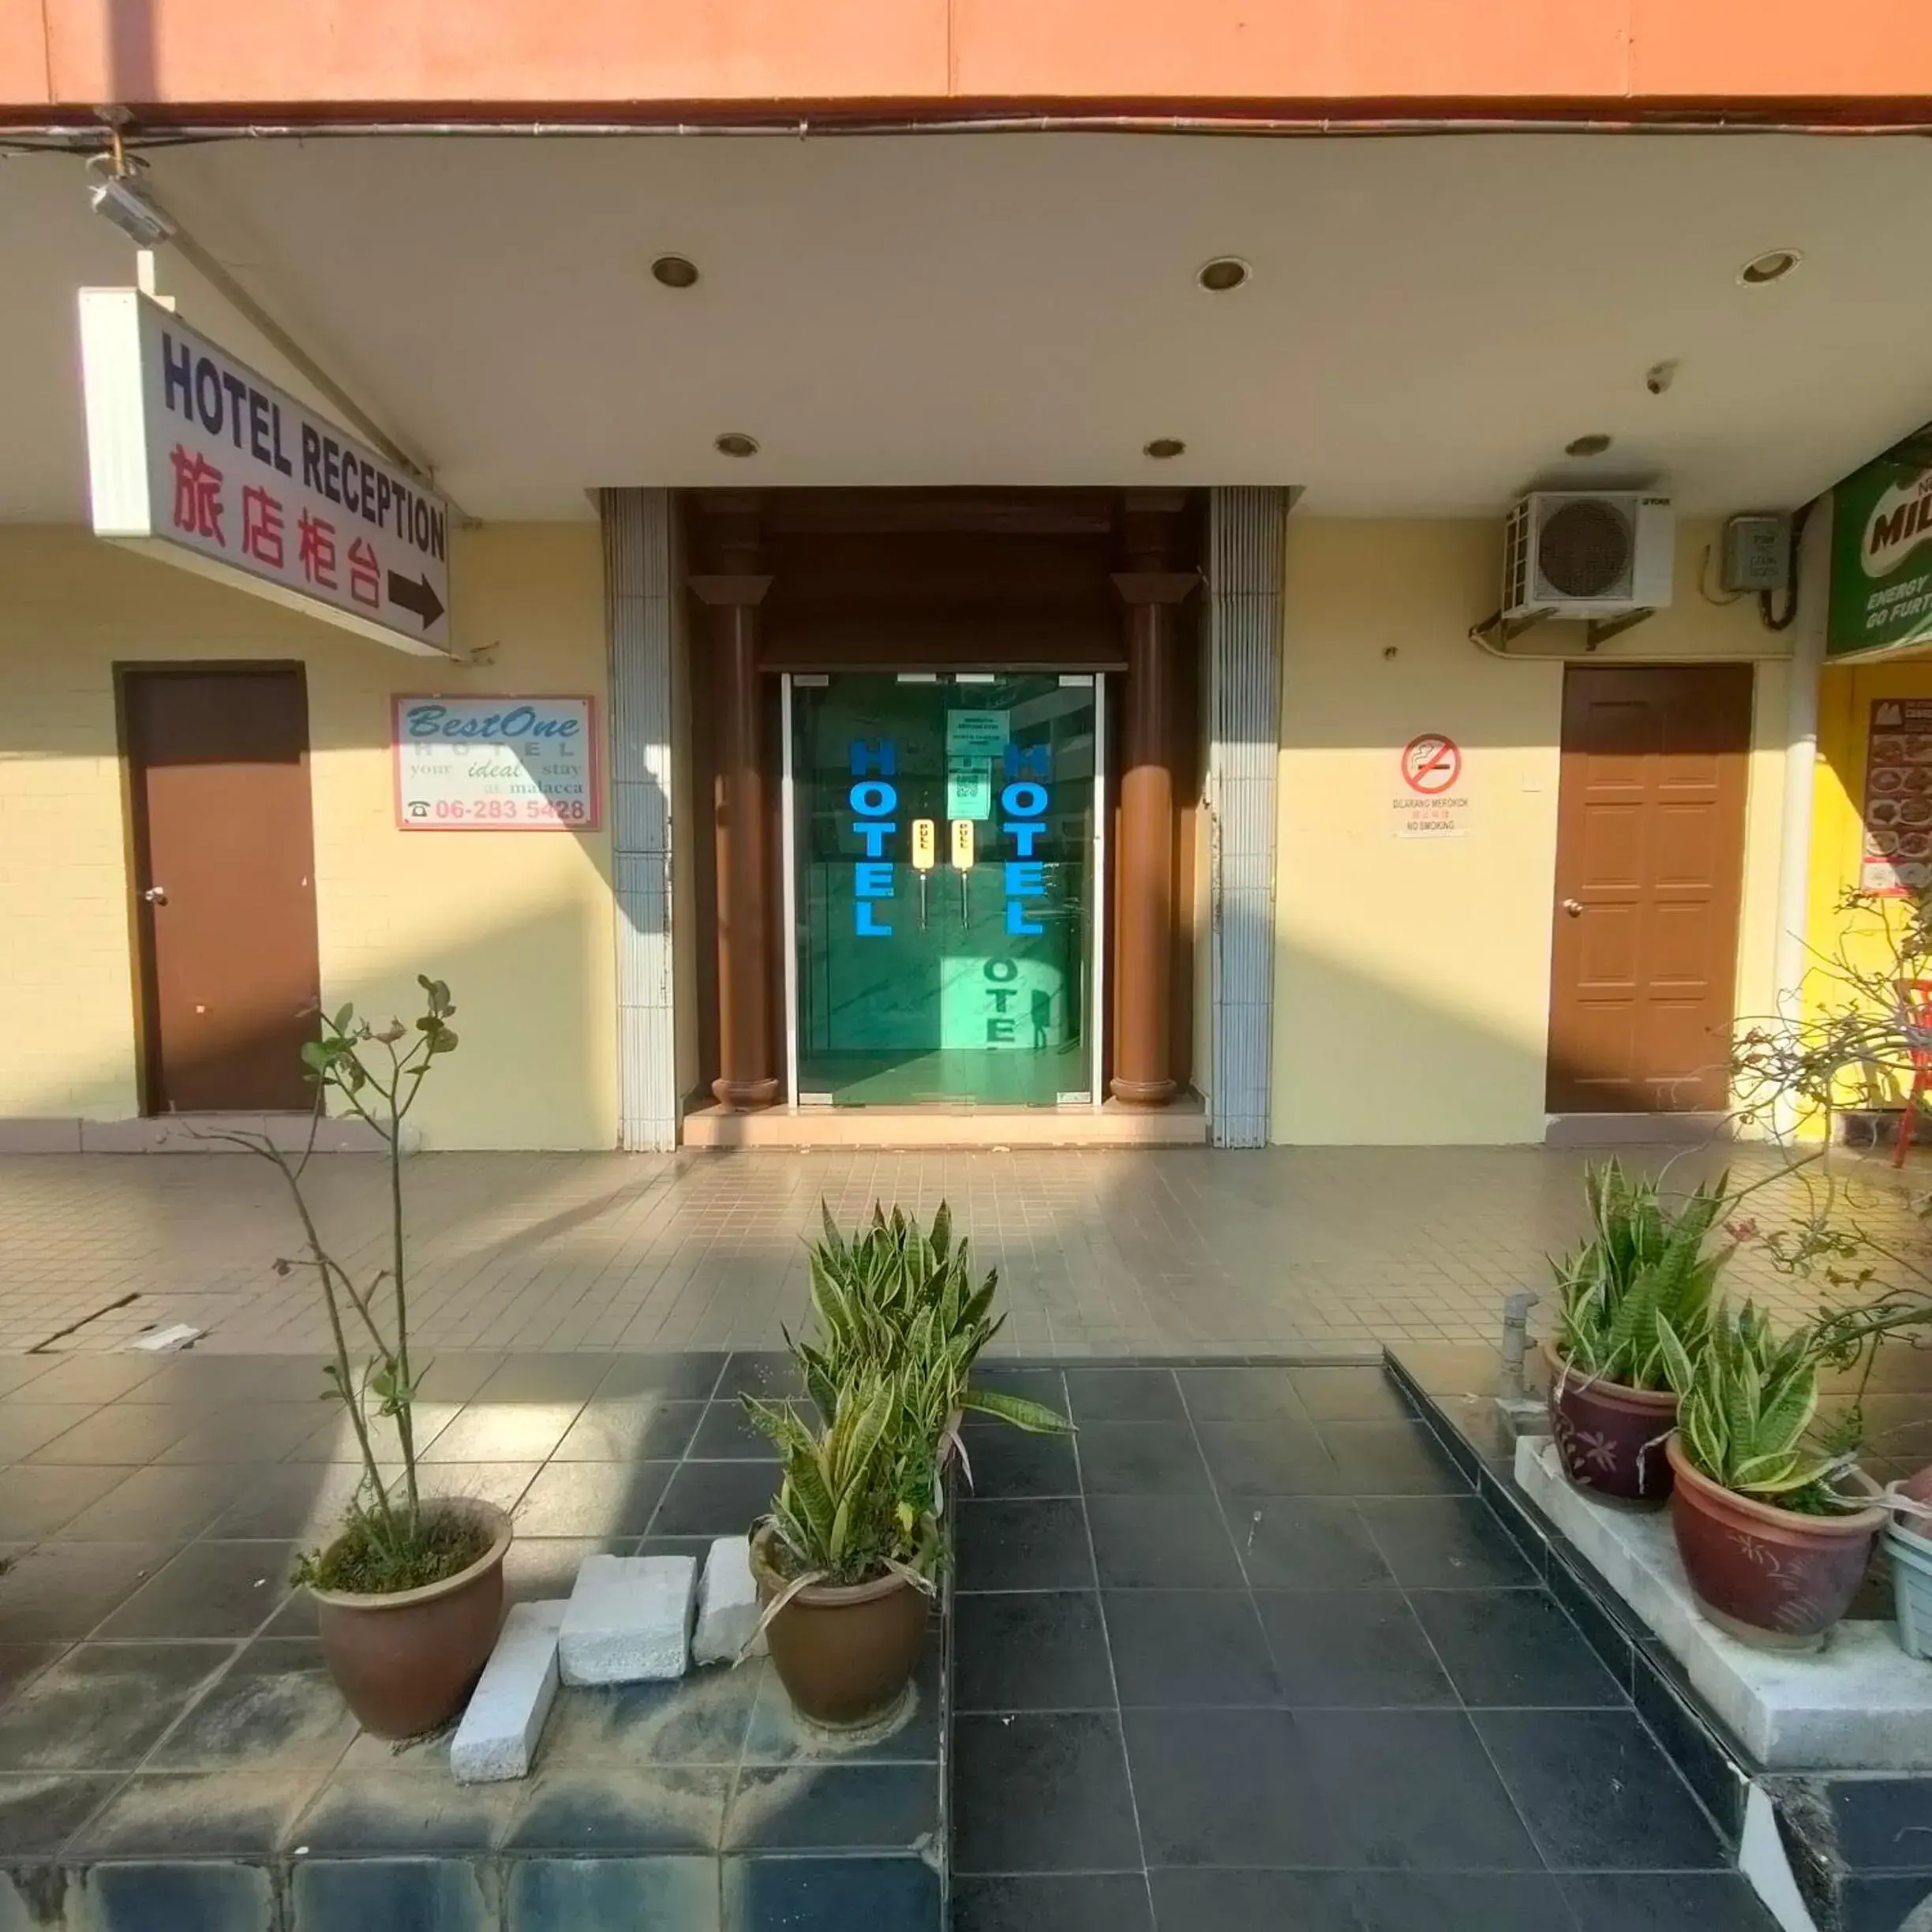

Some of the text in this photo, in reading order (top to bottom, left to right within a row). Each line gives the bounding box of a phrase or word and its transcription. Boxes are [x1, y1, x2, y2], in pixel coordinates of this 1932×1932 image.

[162, 330, 444, 563] HOTEL RECEPTION
[169, 441, 380, 609] 旅店柜台
[1866, 575, 1930, 611] ENERGY
[1866, 592, 1932, 629] GO FURT
[407, 705, 579, 738] BestOne
[414, 741, 575, 757] HOTEL
[410, 758, 582, 778] your ideal stay
[510, 780, 583, 794] malacca
[436, 799, 586, 820] 06-283 5428
[1407, 821, 1418, 830] NO
[848, 739, 898, 936] HOTEL
[1002, 742, 1051, 935] HOTEL
[983, 957, 1018, 1050] OTE
